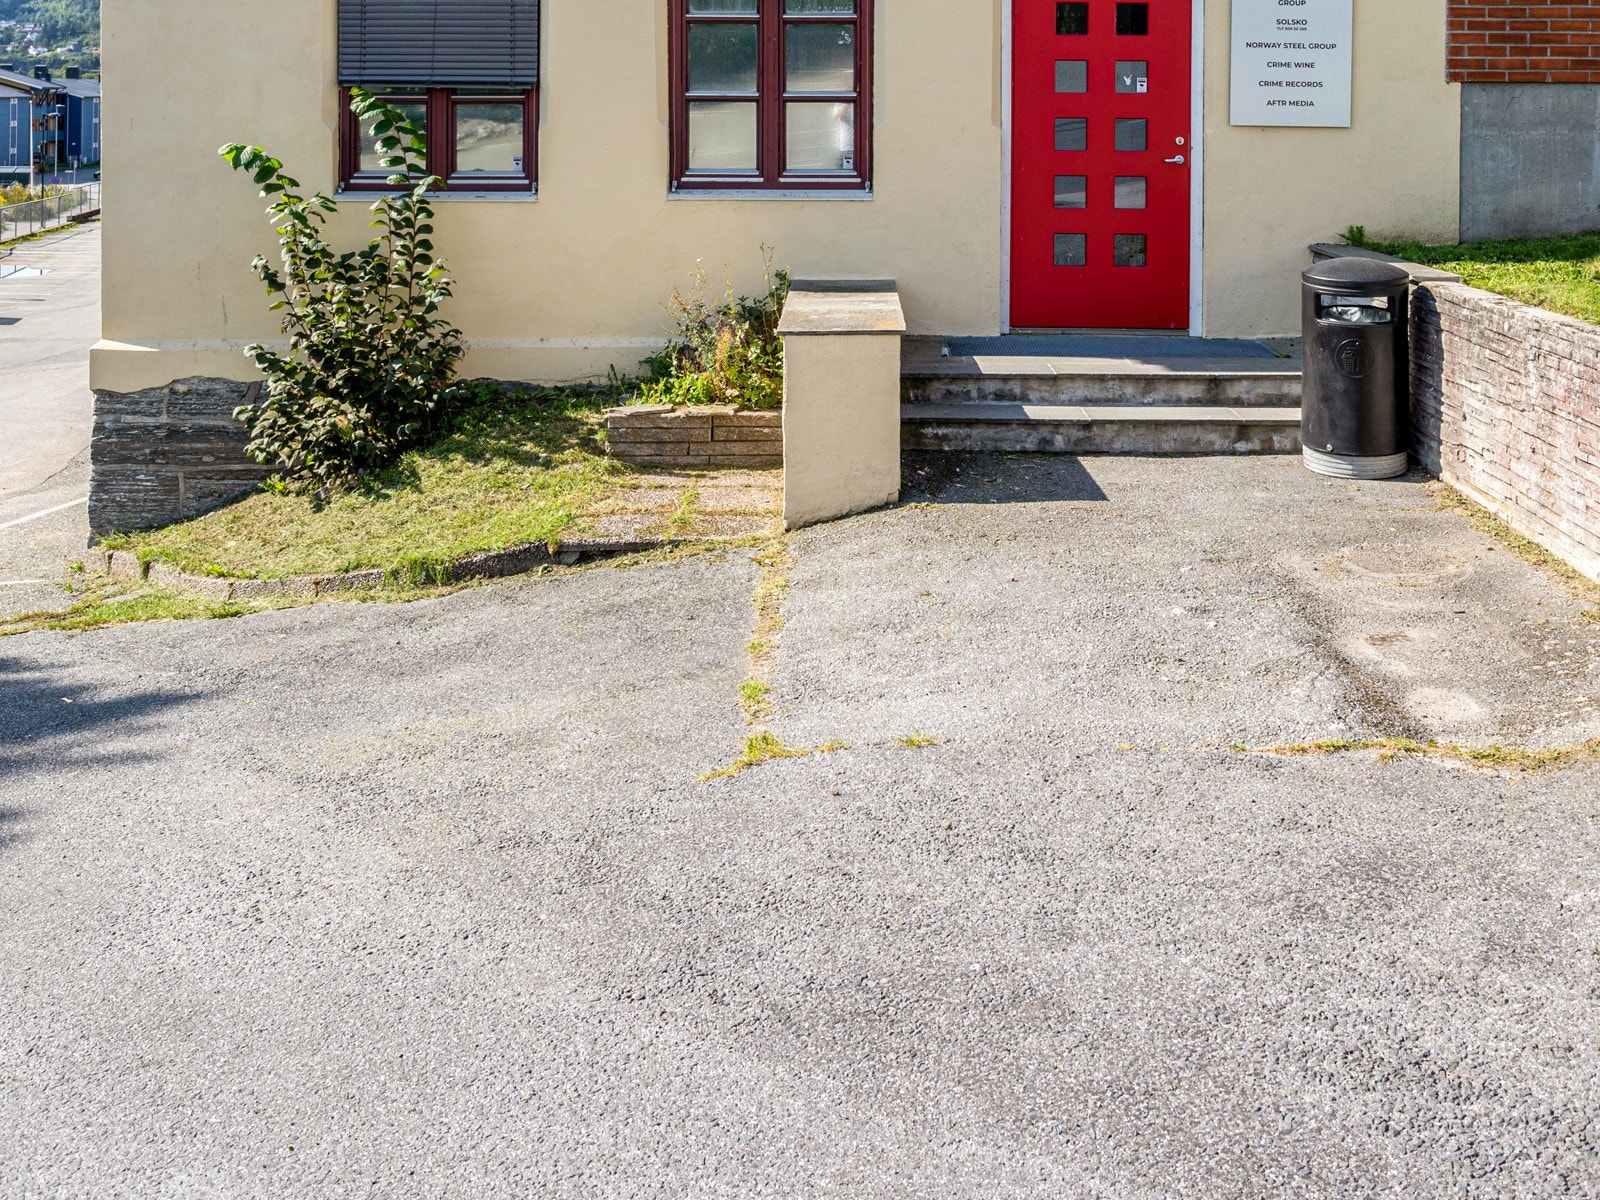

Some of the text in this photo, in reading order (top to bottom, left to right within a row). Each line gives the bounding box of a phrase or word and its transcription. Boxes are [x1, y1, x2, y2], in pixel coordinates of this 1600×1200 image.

[1277, 0, 1307, 7] GROUP
[1276, 18, 1308, 26] SOLSKO
[1245, 41, 1337, 50] NORWAY STEEL GROUP
[1258, 80, 1324, 88] CRIME RECORDS
[1266, 99, 1287, 107] AFTR
